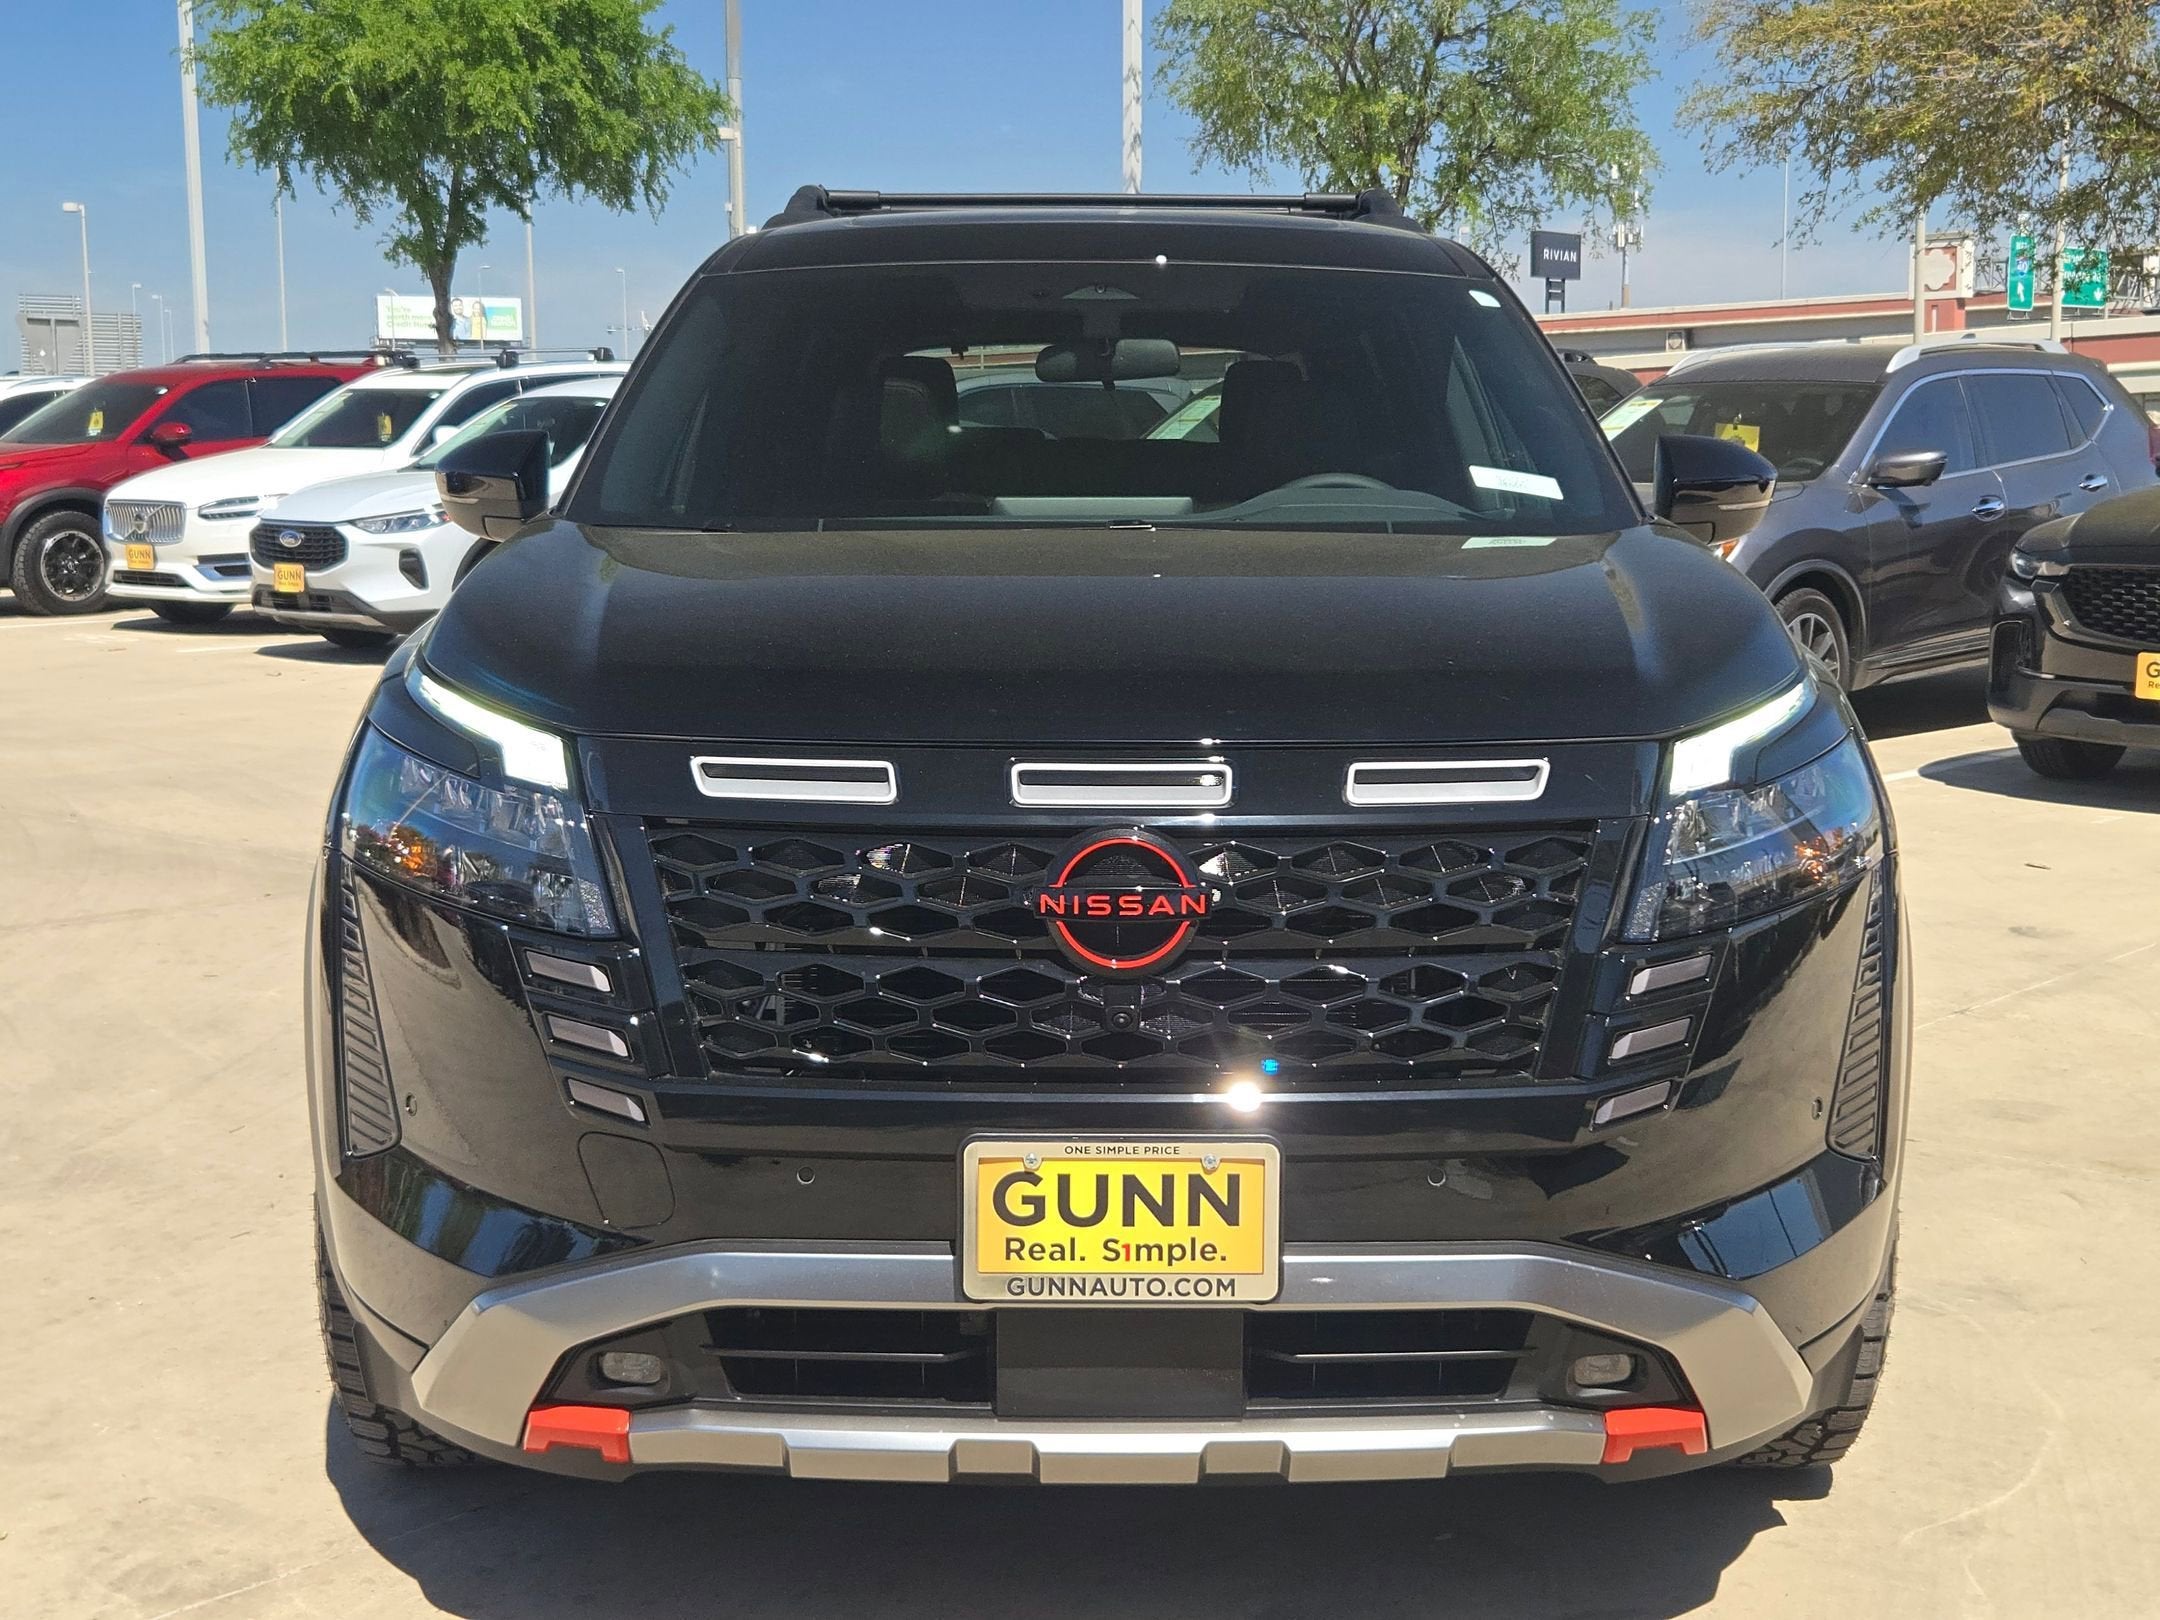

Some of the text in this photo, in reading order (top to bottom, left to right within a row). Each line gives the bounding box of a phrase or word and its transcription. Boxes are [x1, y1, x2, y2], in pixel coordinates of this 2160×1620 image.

[1543, 248, 1577, 262] RIVIAN
[128, 548, 151, 559] GUNN
[278, 569, 302, 581] GUNN
[1039, 893, 1206, 917] NISSAN
[1064, 1145, 1181, 1156] ONE SIMPLE PRICE
[992, 1171, 1241, 1228] GUNN
[1004, 1236, 1086, 1262] Real.
[1006, 1276, 1236, 1297] GUNNAUTO.COM
